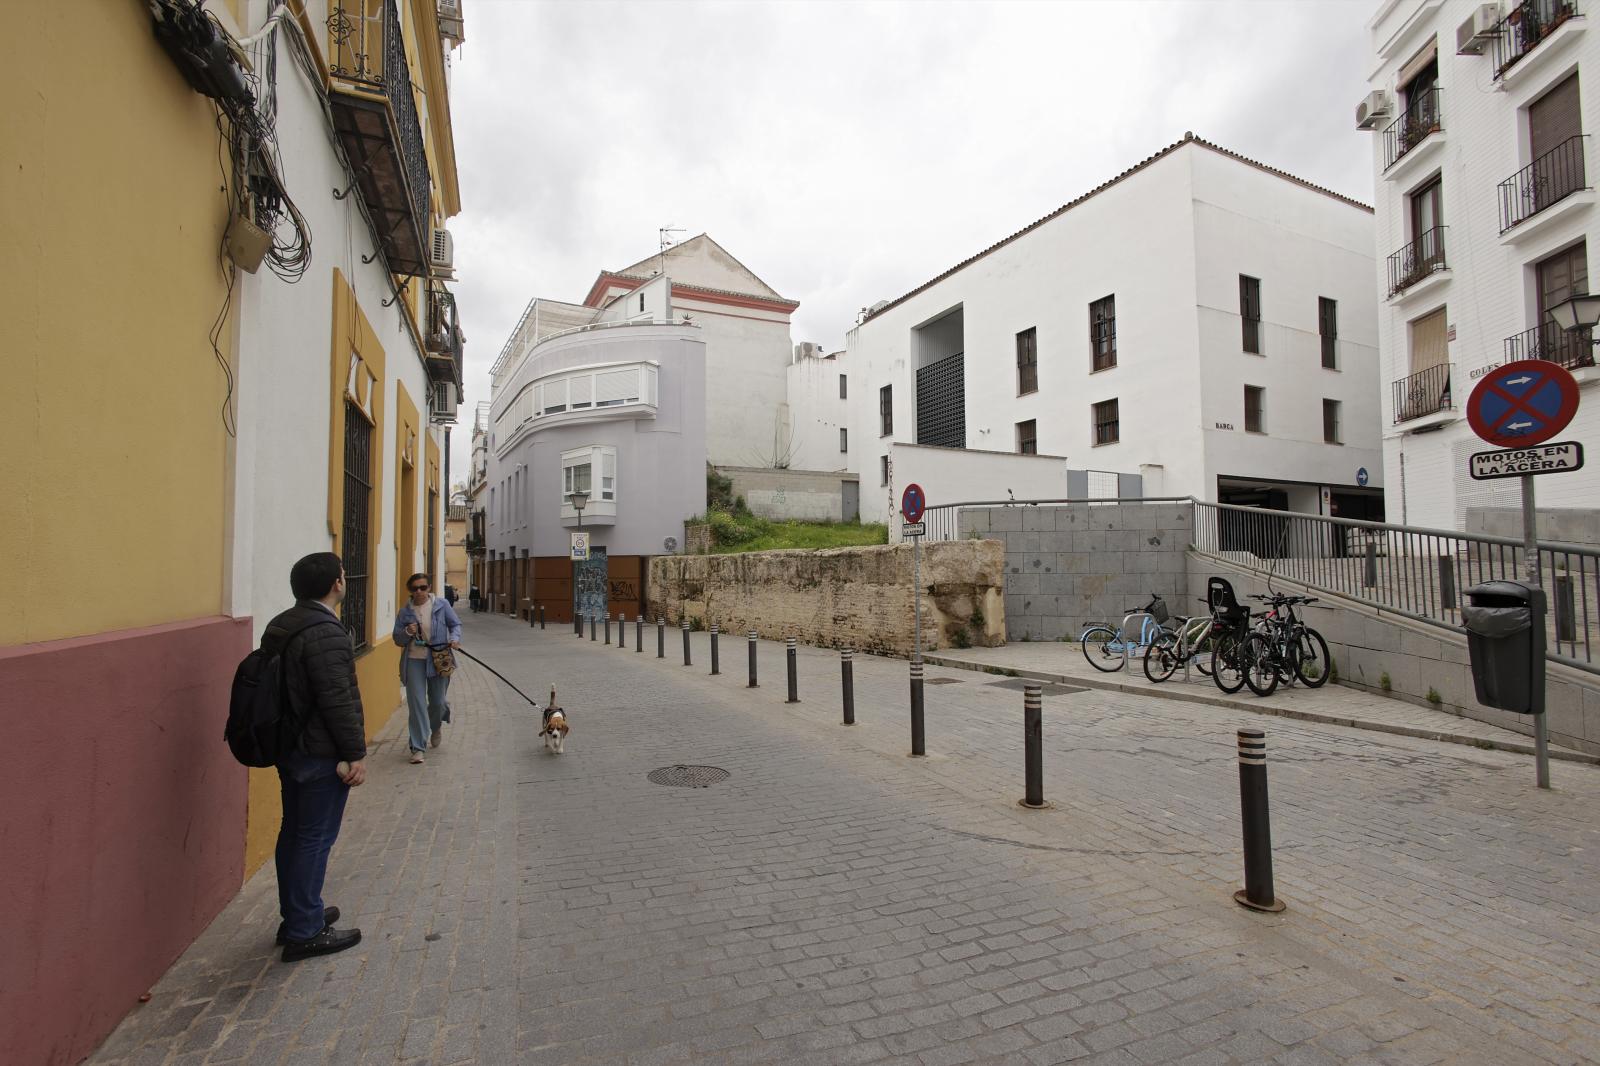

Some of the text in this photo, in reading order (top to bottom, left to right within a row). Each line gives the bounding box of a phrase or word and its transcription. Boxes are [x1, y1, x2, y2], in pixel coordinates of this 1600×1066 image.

[1476, 449, 1538, 464] MOTOS
[1544, 445, 1569, 457] EN
[1479, 466, 1500, 476] LA
[1505, 458, 1568, 473] ACERA
